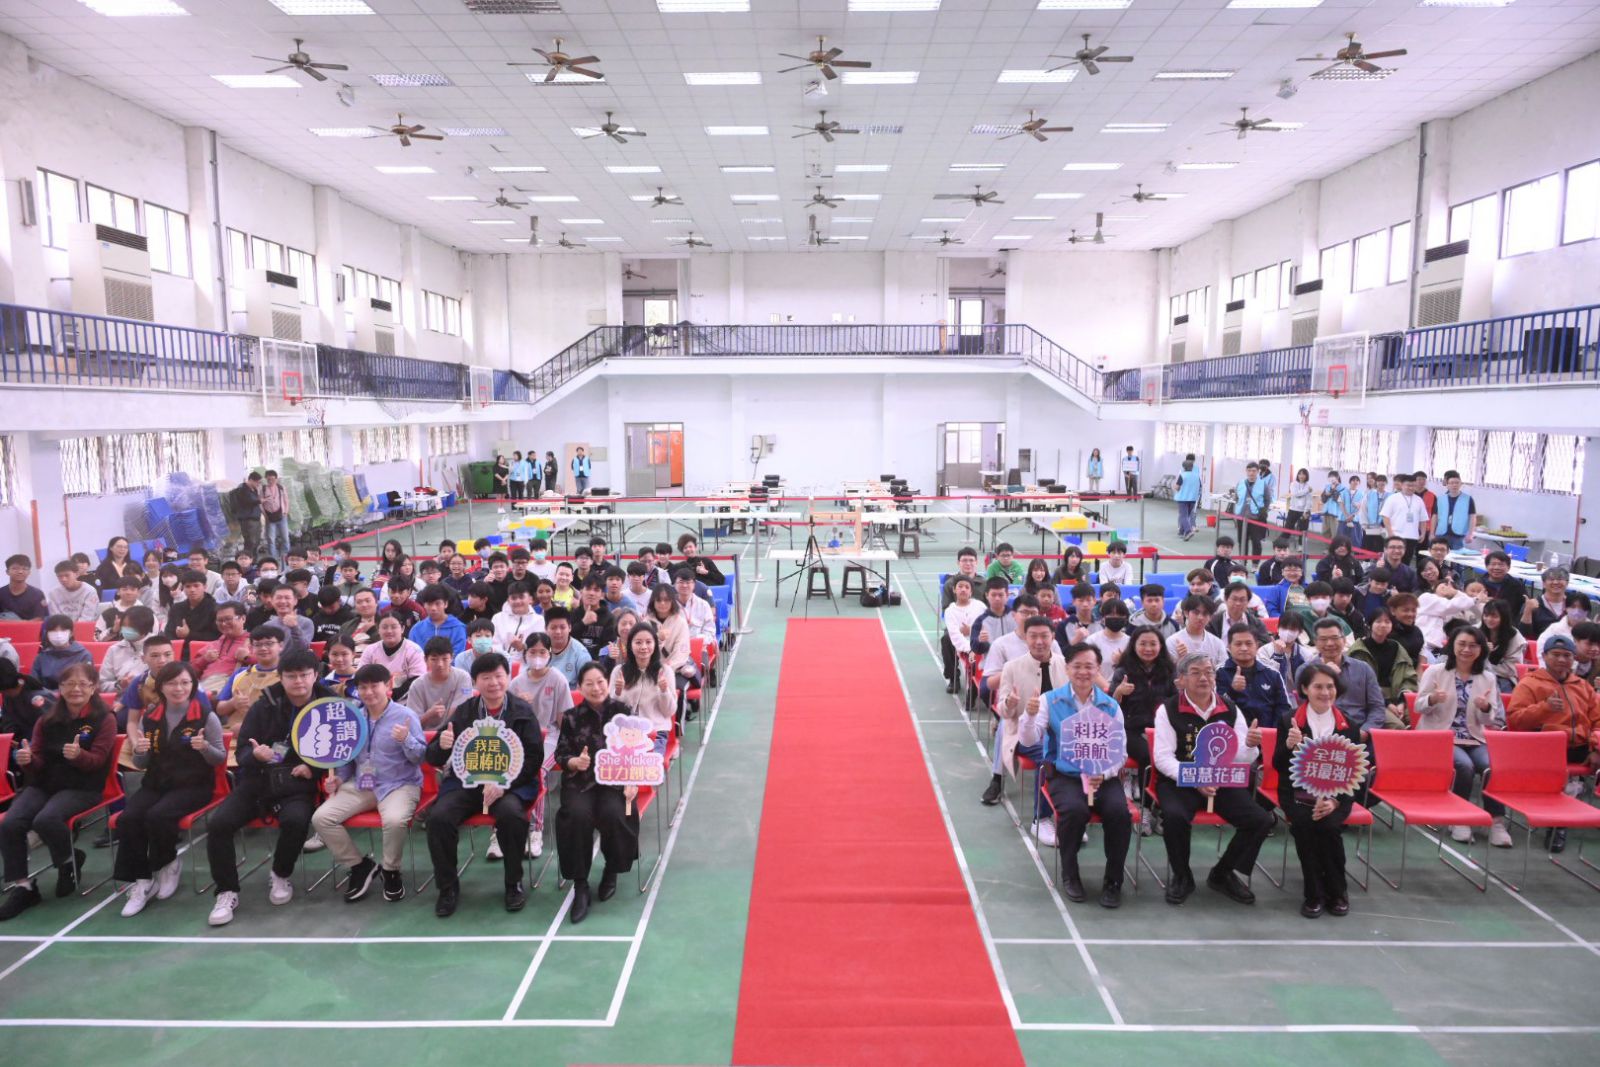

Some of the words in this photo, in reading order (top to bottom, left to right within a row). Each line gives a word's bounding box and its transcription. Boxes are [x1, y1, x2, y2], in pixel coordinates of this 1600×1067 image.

[326, 701, 357, 761] 超讚的
[1074, 722, 1108, 739] 科技
[474, 739, 501, 752] 我是
[1074, 742, 1108, 760] 領航
[466, 752, 509, 772] 最棒的
[600, 754, 620, 766] She
[624, 753, 658, 766] Maker
[1313, 748, 1347, 764] 全場
[1182, 767, 1246, 784] 智慧花蓮
